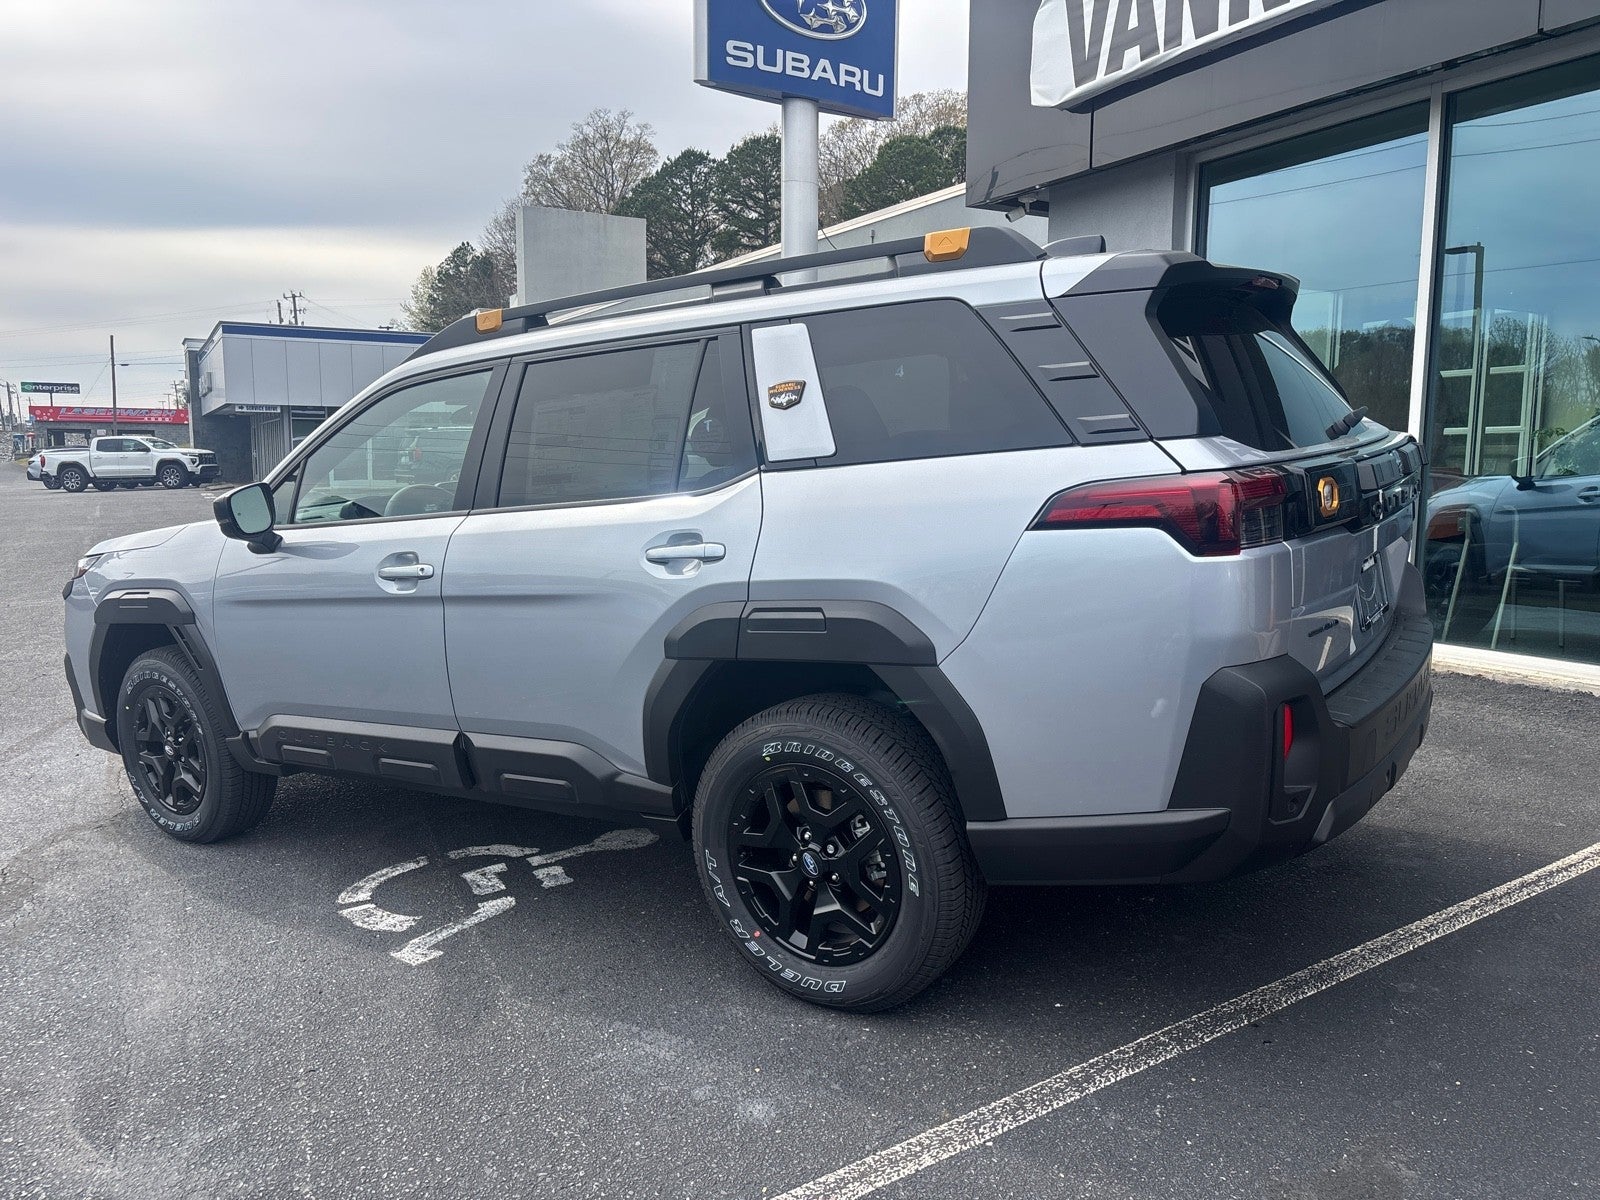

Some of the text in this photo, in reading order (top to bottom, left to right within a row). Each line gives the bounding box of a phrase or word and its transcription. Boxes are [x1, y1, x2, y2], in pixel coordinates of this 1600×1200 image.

[725, 39, 884, 98] SUBARU
[24, 384, 79, 392] enterprise
[278, 730, 388, 753] OUTBACK
[762, 741, 920, 897] BRIDGESTONE
[705, 850, 847, 993] DUELER A/T
